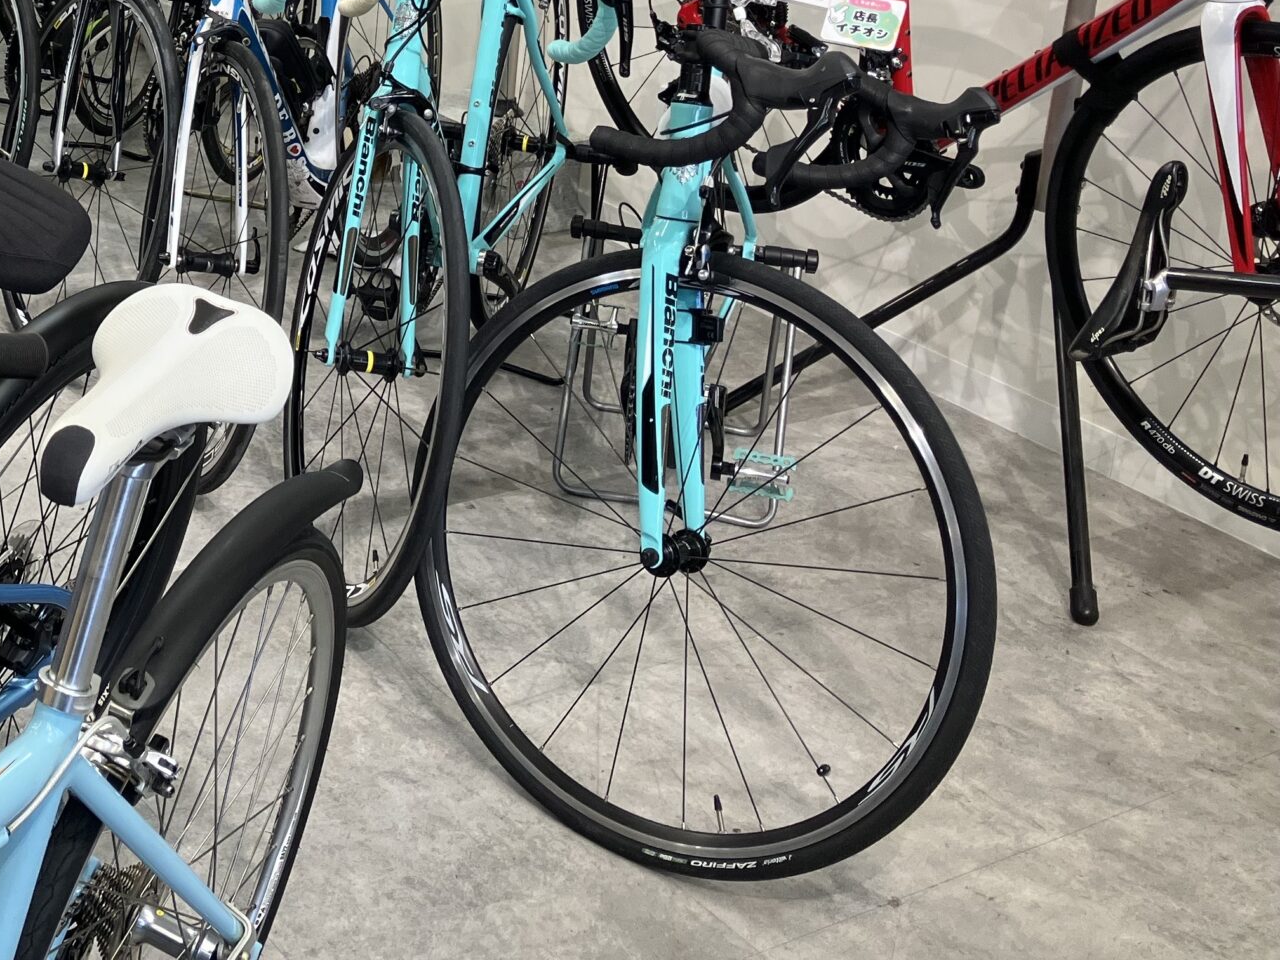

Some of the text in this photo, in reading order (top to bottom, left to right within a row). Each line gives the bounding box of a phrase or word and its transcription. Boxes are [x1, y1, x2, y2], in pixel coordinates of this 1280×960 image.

[853, 10, 879, 24] 店長
[836, 24, 889, 39] イチオシ
[351, 116, 377, 219] Bianchi
[660, 272, 678, 399] Bianchi
[1198, 466, 1267, 508] DT SWISS
[689, 859, 758, 870] ZAFFIRO
